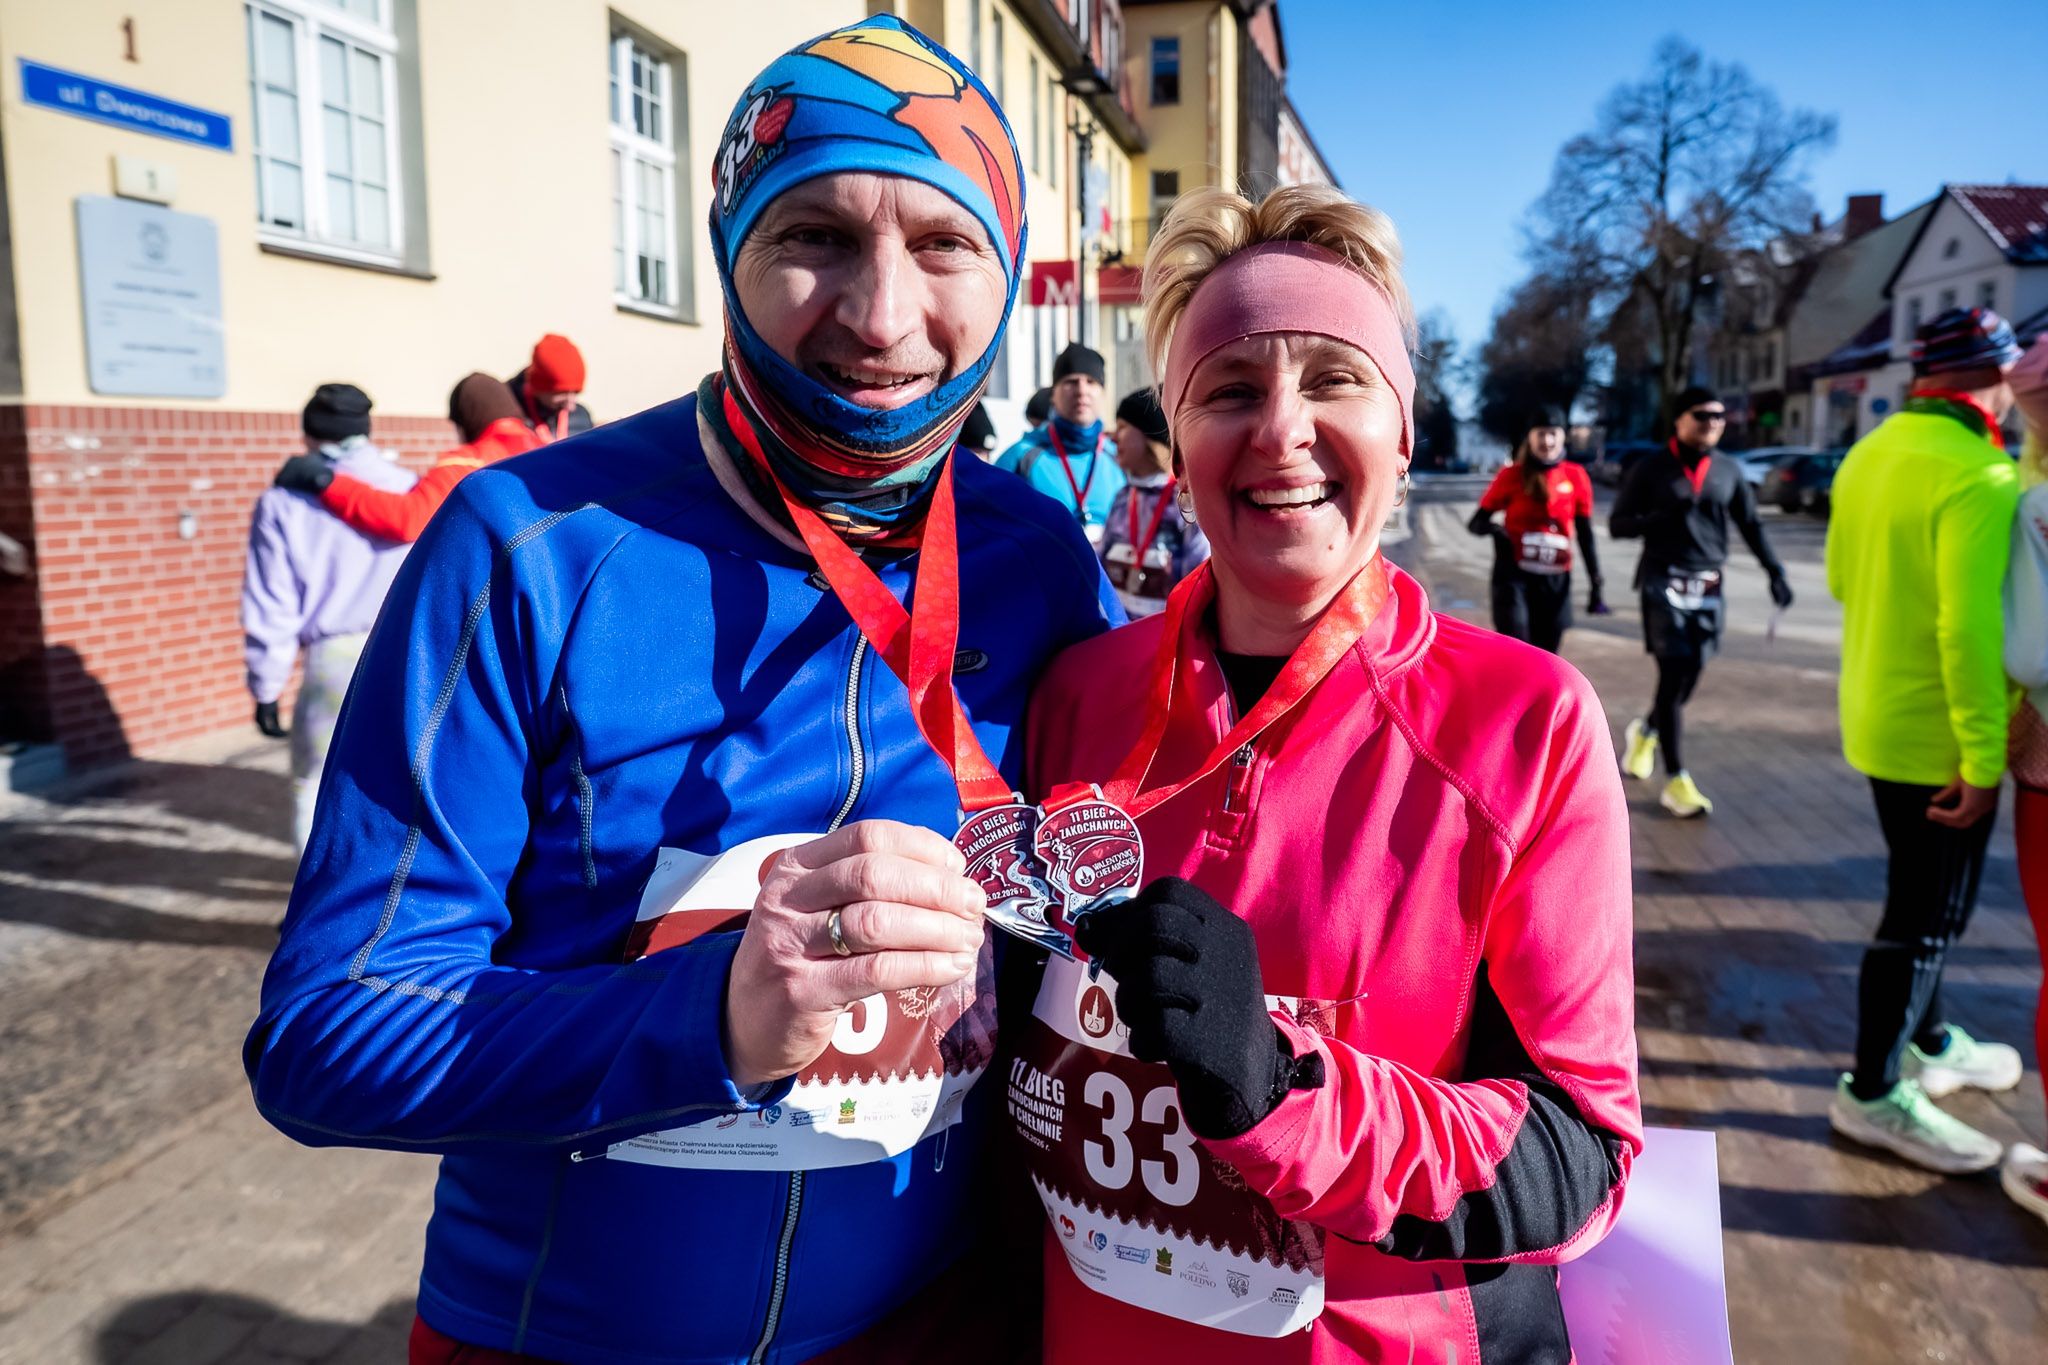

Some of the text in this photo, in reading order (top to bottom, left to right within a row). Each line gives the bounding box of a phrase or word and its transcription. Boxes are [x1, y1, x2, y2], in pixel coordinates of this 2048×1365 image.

[118, 16, 140, 64] 1
[970, 813, 1007, 838] 11 BIEG
[1069, 807, 1106, 823] 11 BIEG
[963, 820, 1027, 858] ZAKOCHANYCH
[1059, 819, 1127, 840] ZAKOCHANYCH
[986, 887, 1019, 902] 5.02.2026
[1087, 1017, 1100, 1031] 25
[1007, 1084, 1063, 1123] ZAKOCHANYCH
[1016, 1106, 1063, 1142] CHEŁMNIE
[659, 1139, 678, 1147] Miasta
[1083, 1071, 1201, 1208] 33
[737, 1149, 779, 1158] Olszewskiego
